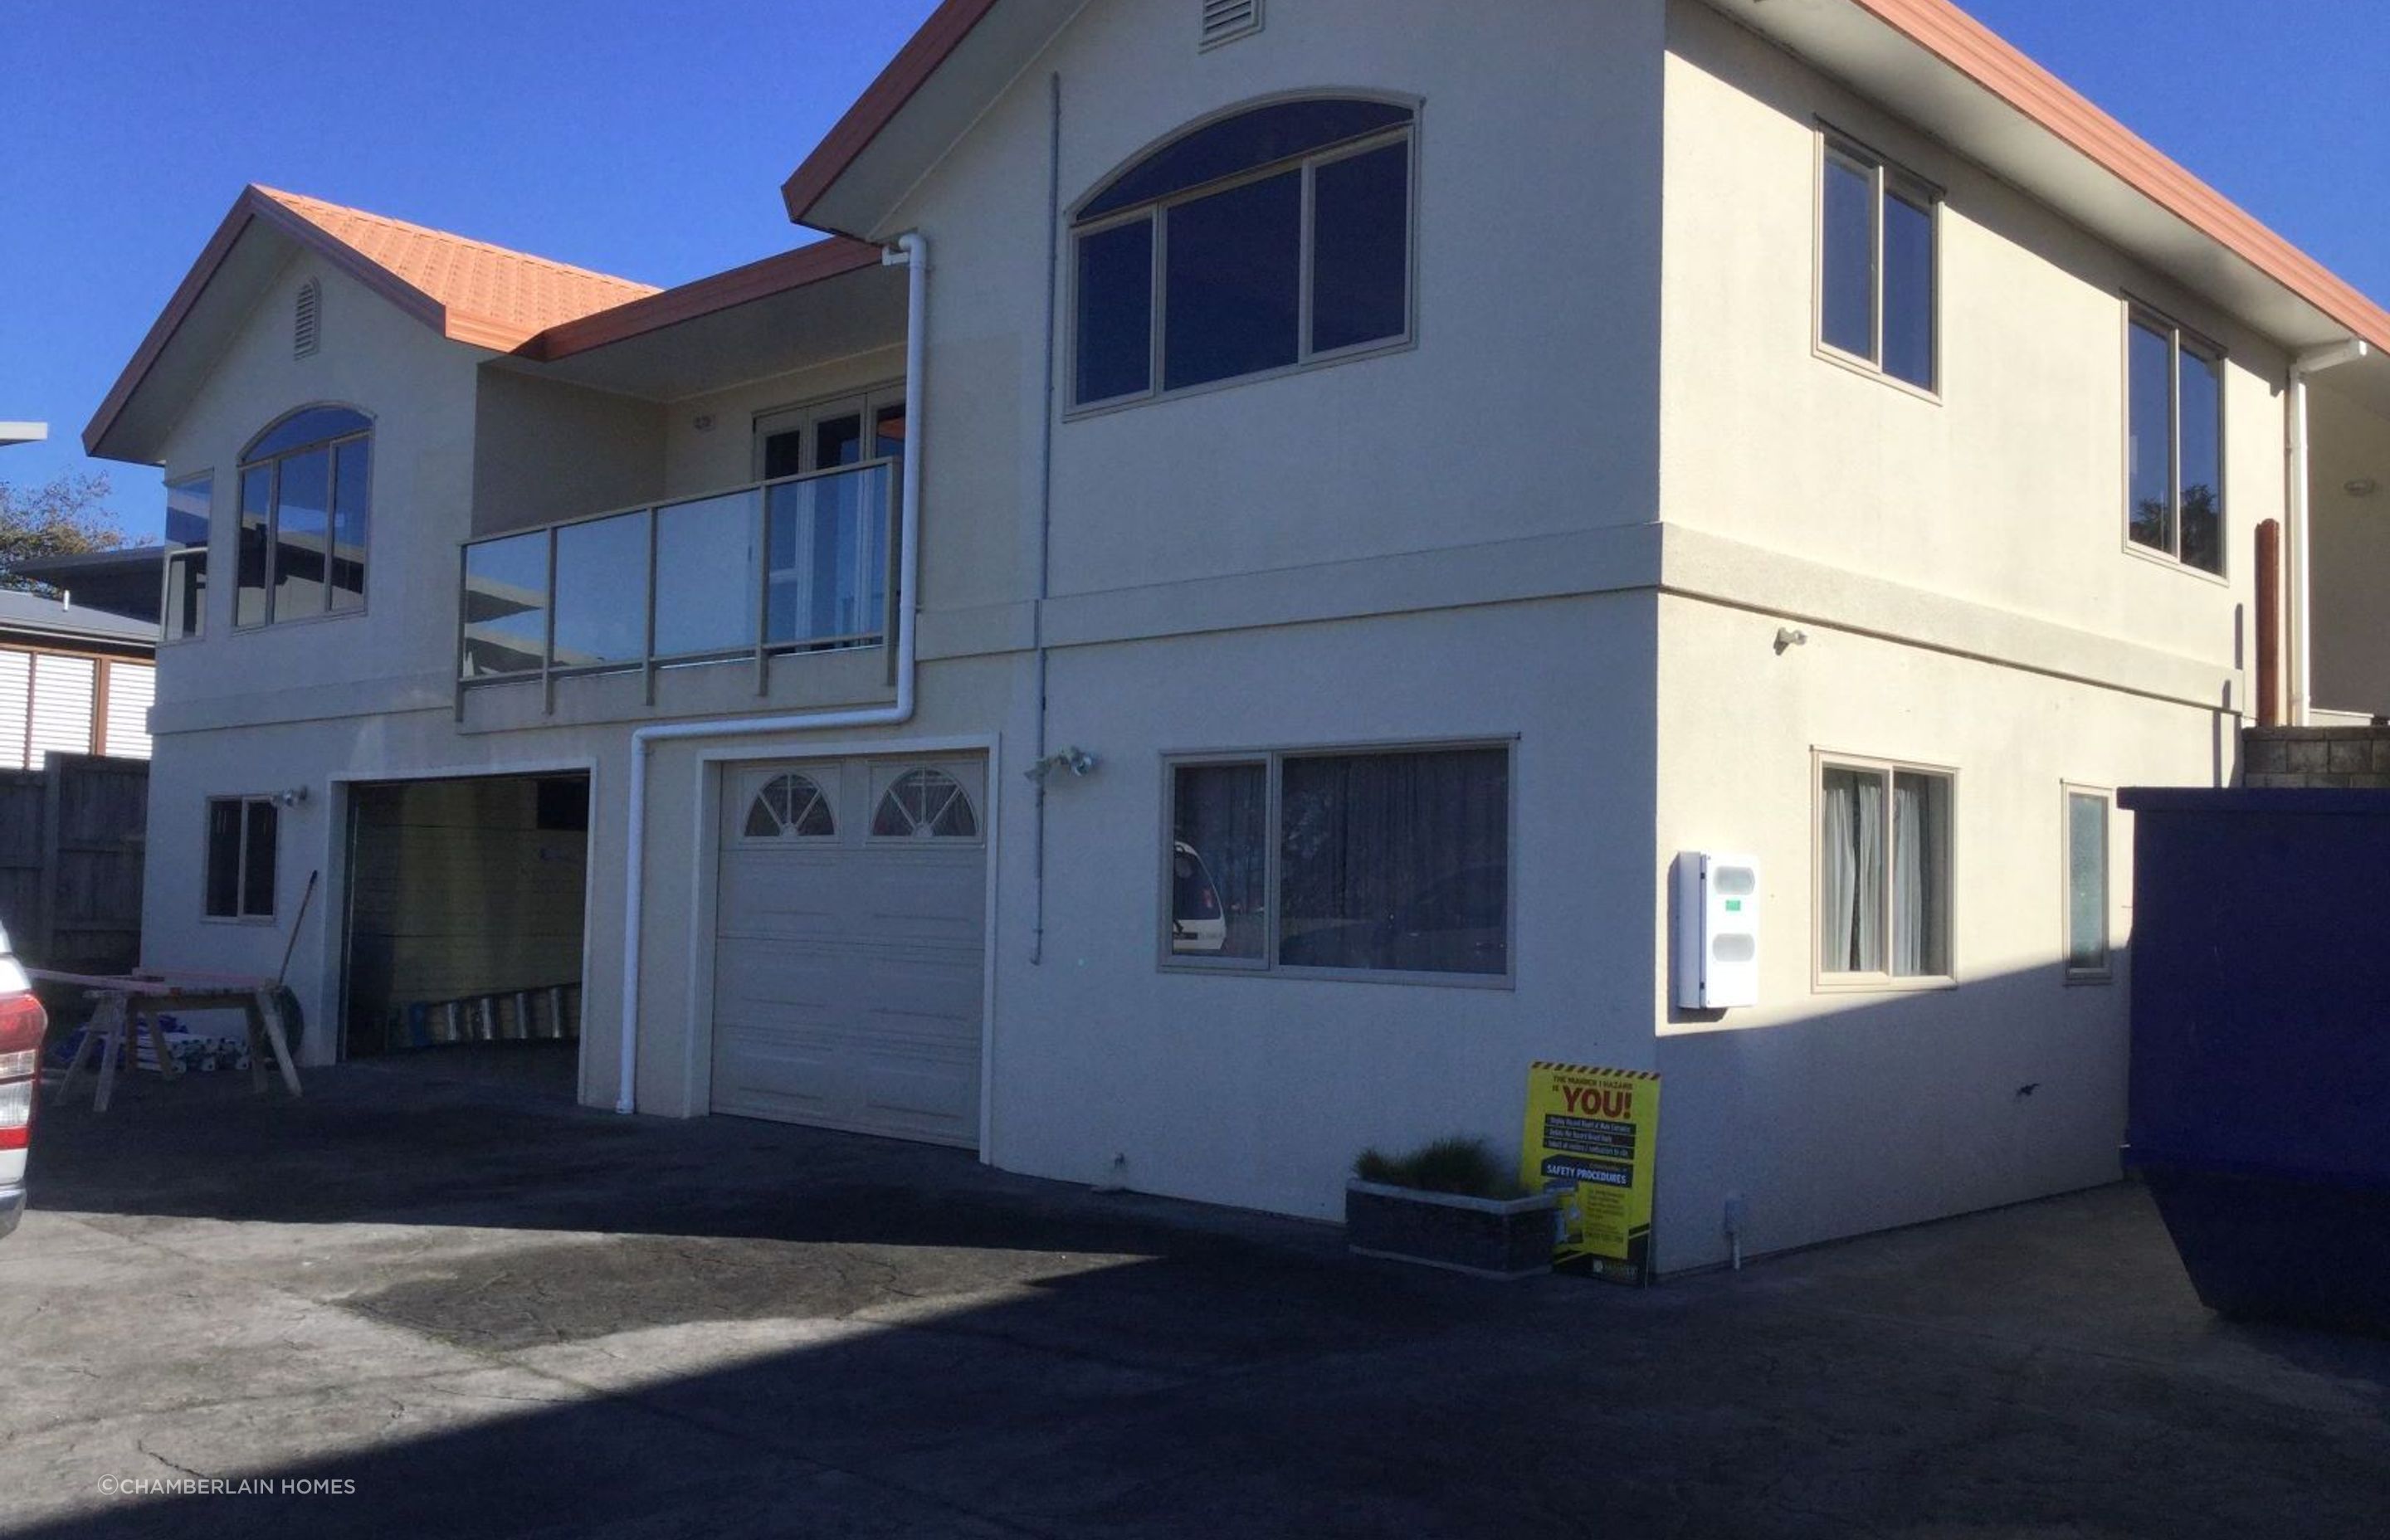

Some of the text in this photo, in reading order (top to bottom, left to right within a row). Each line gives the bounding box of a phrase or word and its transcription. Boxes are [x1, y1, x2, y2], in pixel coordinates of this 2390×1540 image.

[1563, 1085, 1632, 1119] YOU!
[1546, 1163, 1575, 1177] SAFETY
[1577, 1167, 1627, 1185] PROCEDURES
